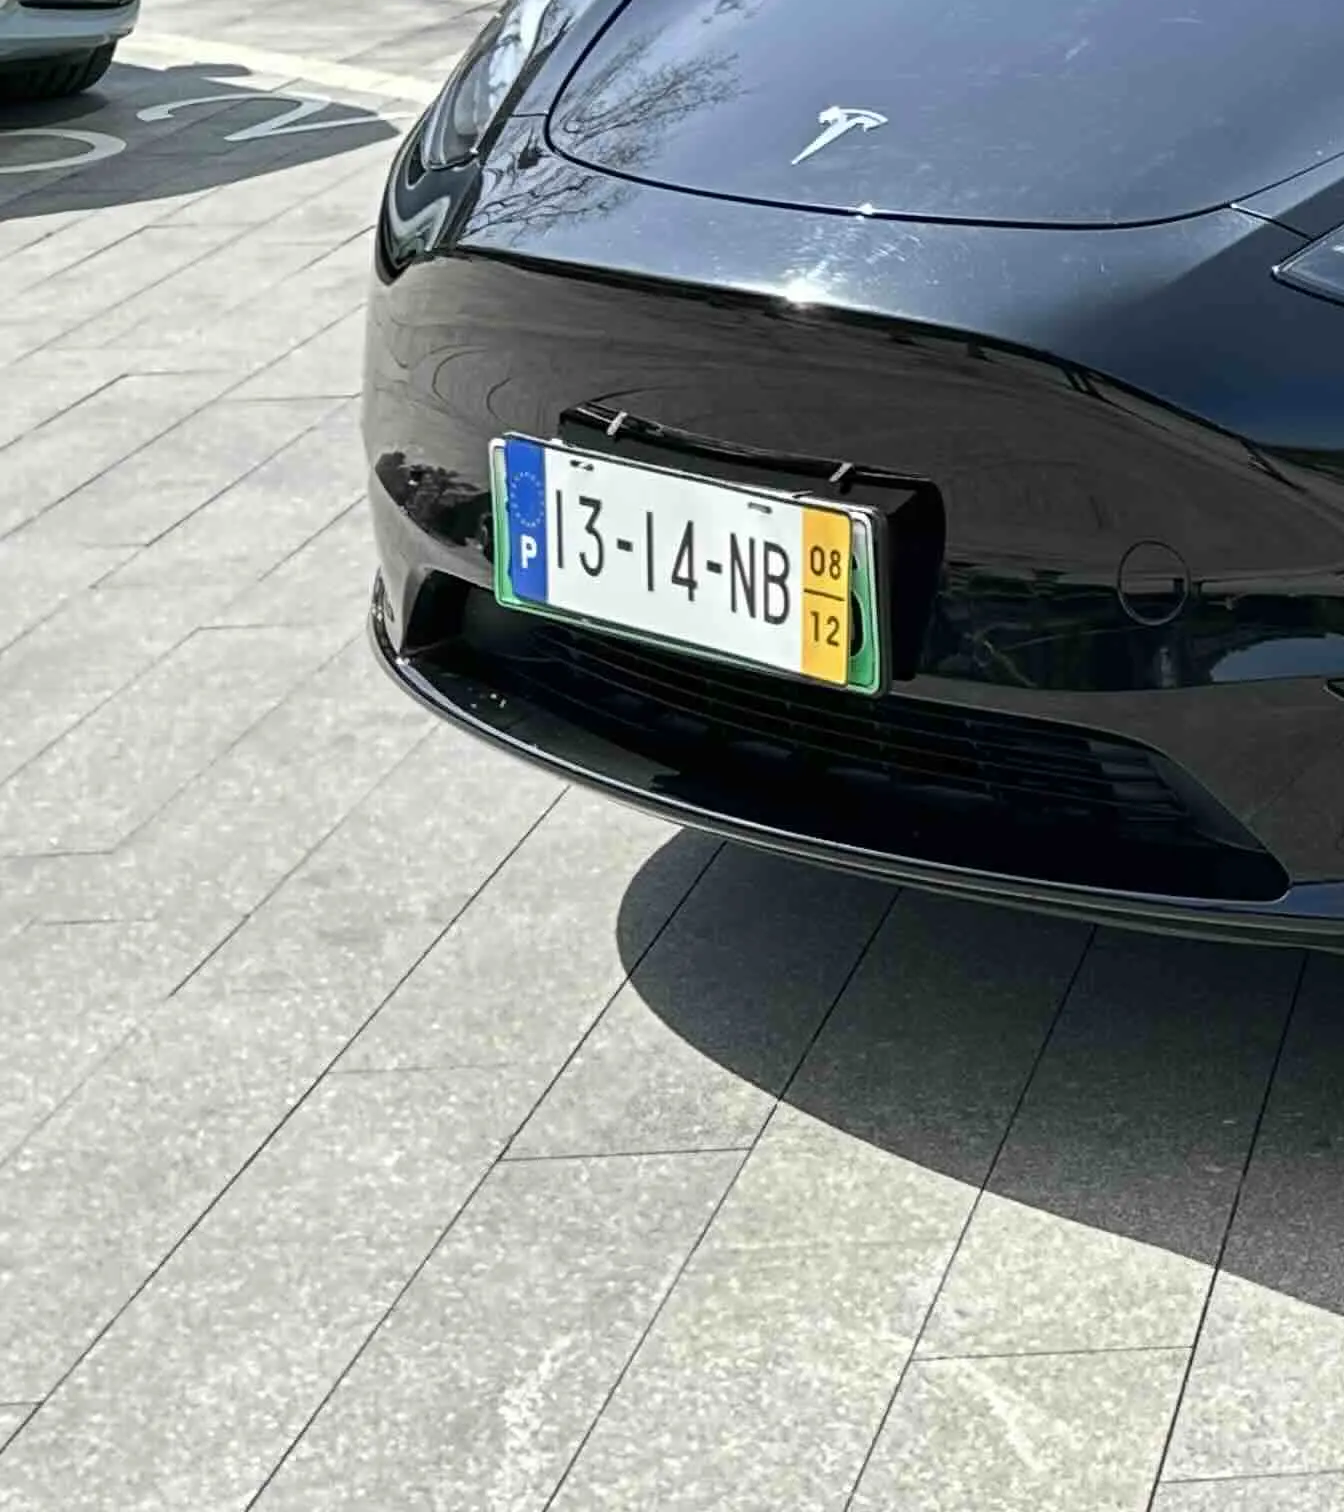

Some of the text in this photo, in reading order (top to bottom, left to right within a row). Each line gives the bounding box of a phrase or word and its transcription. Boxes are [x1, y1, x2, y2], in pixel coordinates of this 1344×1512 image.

[521, 535, 537, 569] P
[556, 489, 790, 626] 13-14-NB
[809, 545, 841, 581] 08
[809, 611, 840, 648] 12
